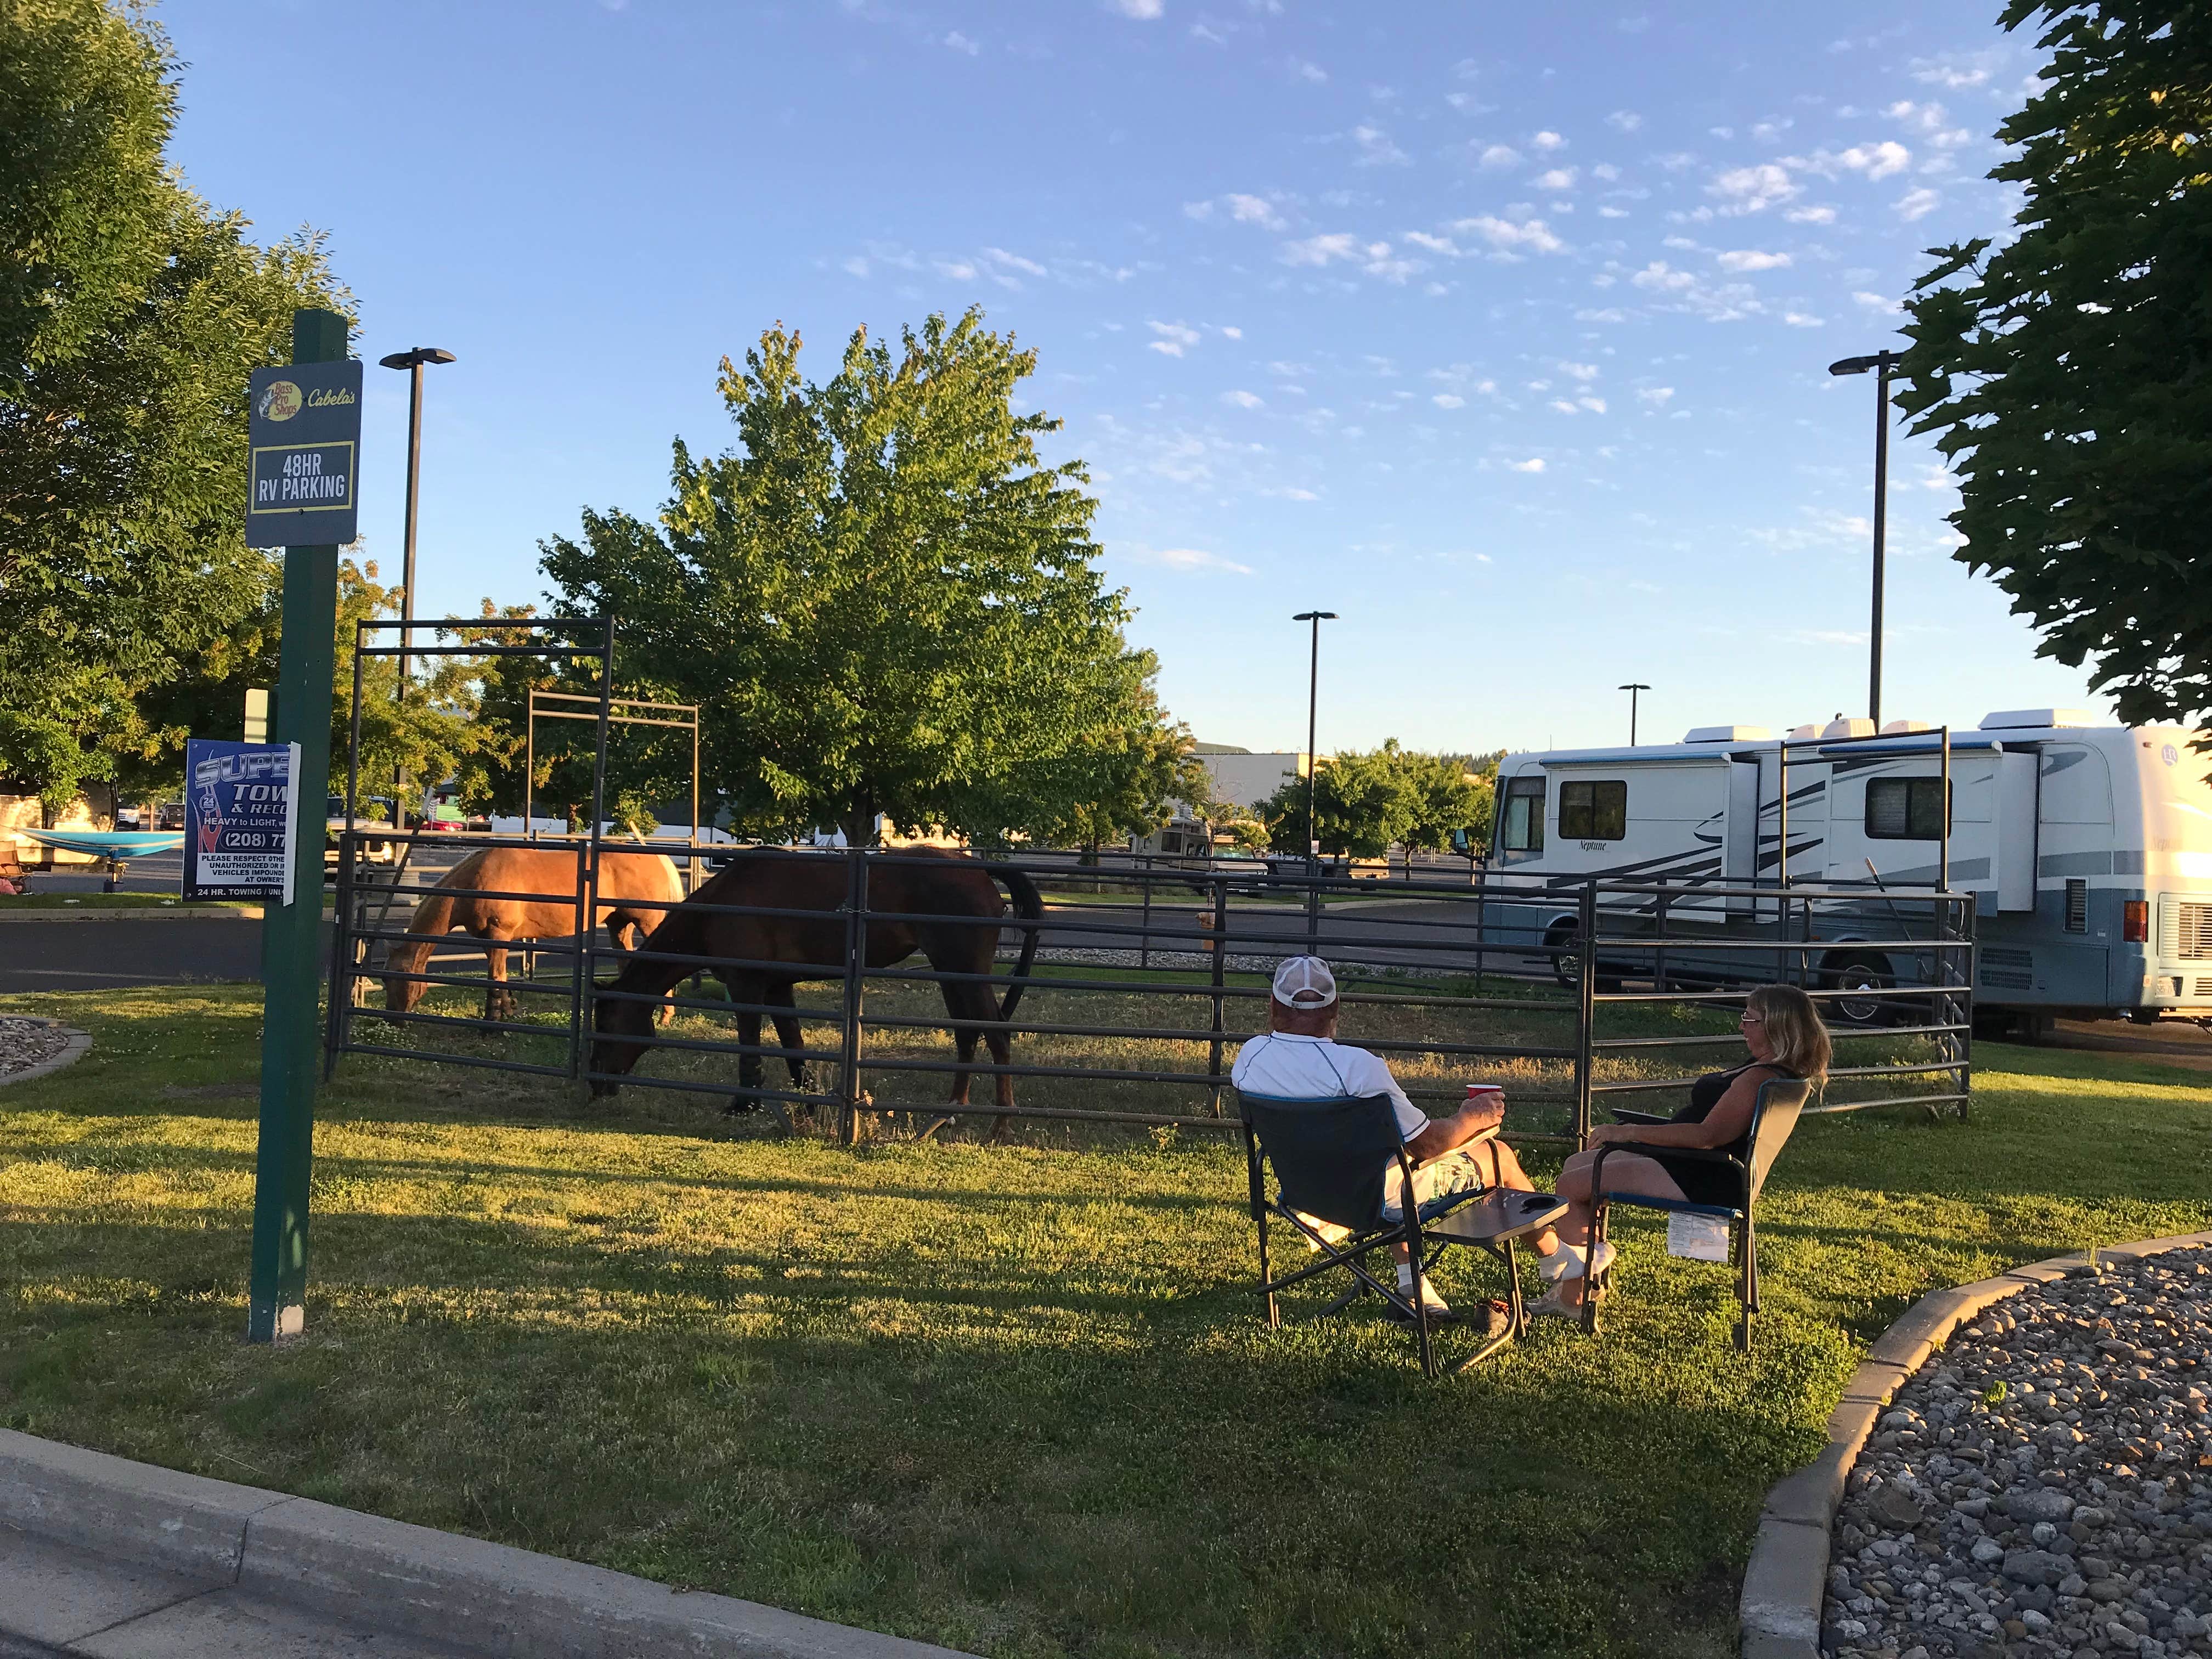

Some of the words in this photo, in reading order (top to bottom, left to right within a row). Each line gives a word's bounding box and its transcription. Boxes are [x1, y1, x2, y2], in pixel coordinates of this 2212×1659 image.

[275, 383, 293, 394] Bass
[275, 394, 289, 405] Pro
[308, 387, 356, 407] Cabela's
[275, 404, 297, 417] Shops
[283, 453, 321, 477] 48HR
[259, 478, 278, 501] RV
[282, 475, 345, 500] PARKING
[195, 752, 290, 789] SUPE
[231, 803, 244, 813] &
[250, 819, 276, 828] LIGHT,
[225, 833, 266, 847] (208)
[1579, 840, 1606, 852] Neptune
